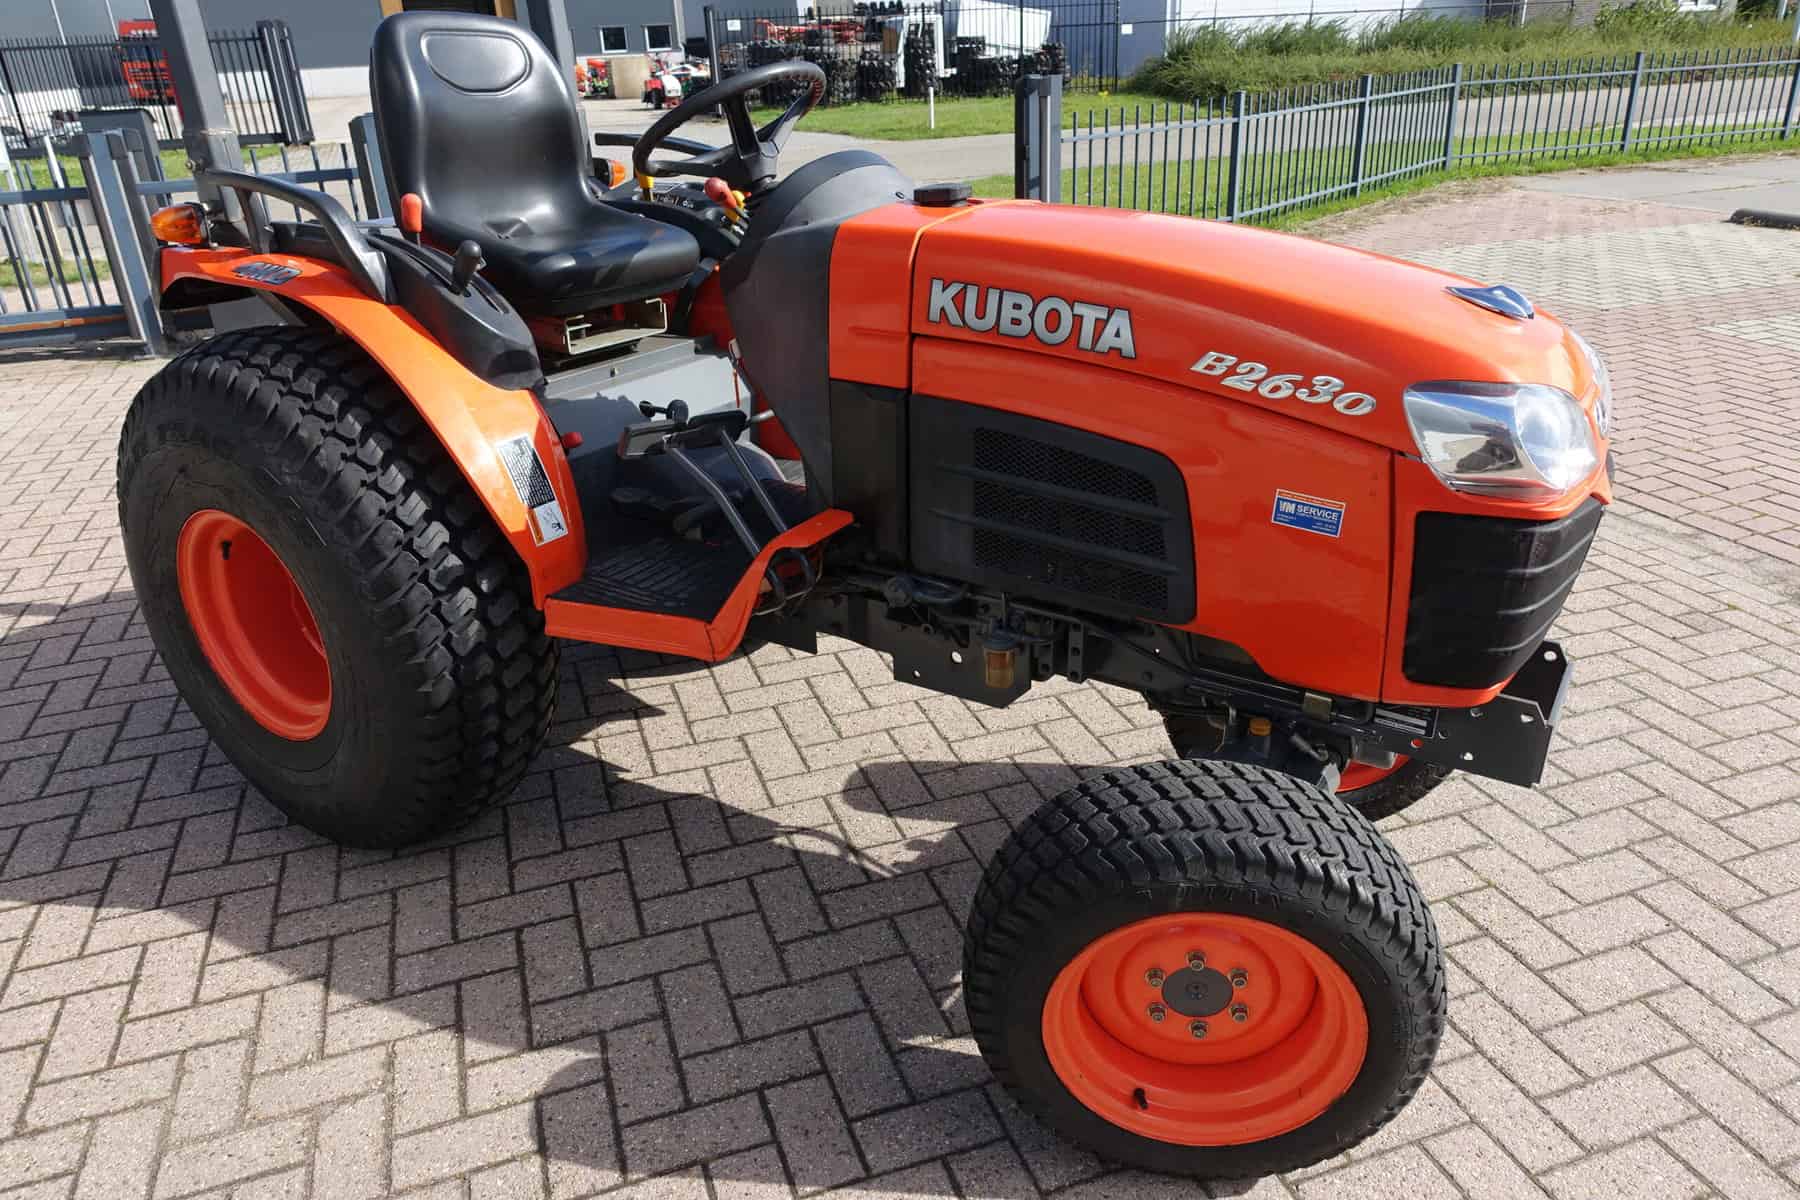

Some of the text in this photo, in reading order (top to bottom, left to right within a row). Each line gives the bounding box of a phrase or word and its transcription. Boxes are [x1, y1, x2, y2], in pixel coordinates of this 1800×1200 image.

[928, 278, 1136, 359] KUBOTA
[1190, 351, 1377, 416] B2630
[1297, 504, 1338, 521] SERVICE
